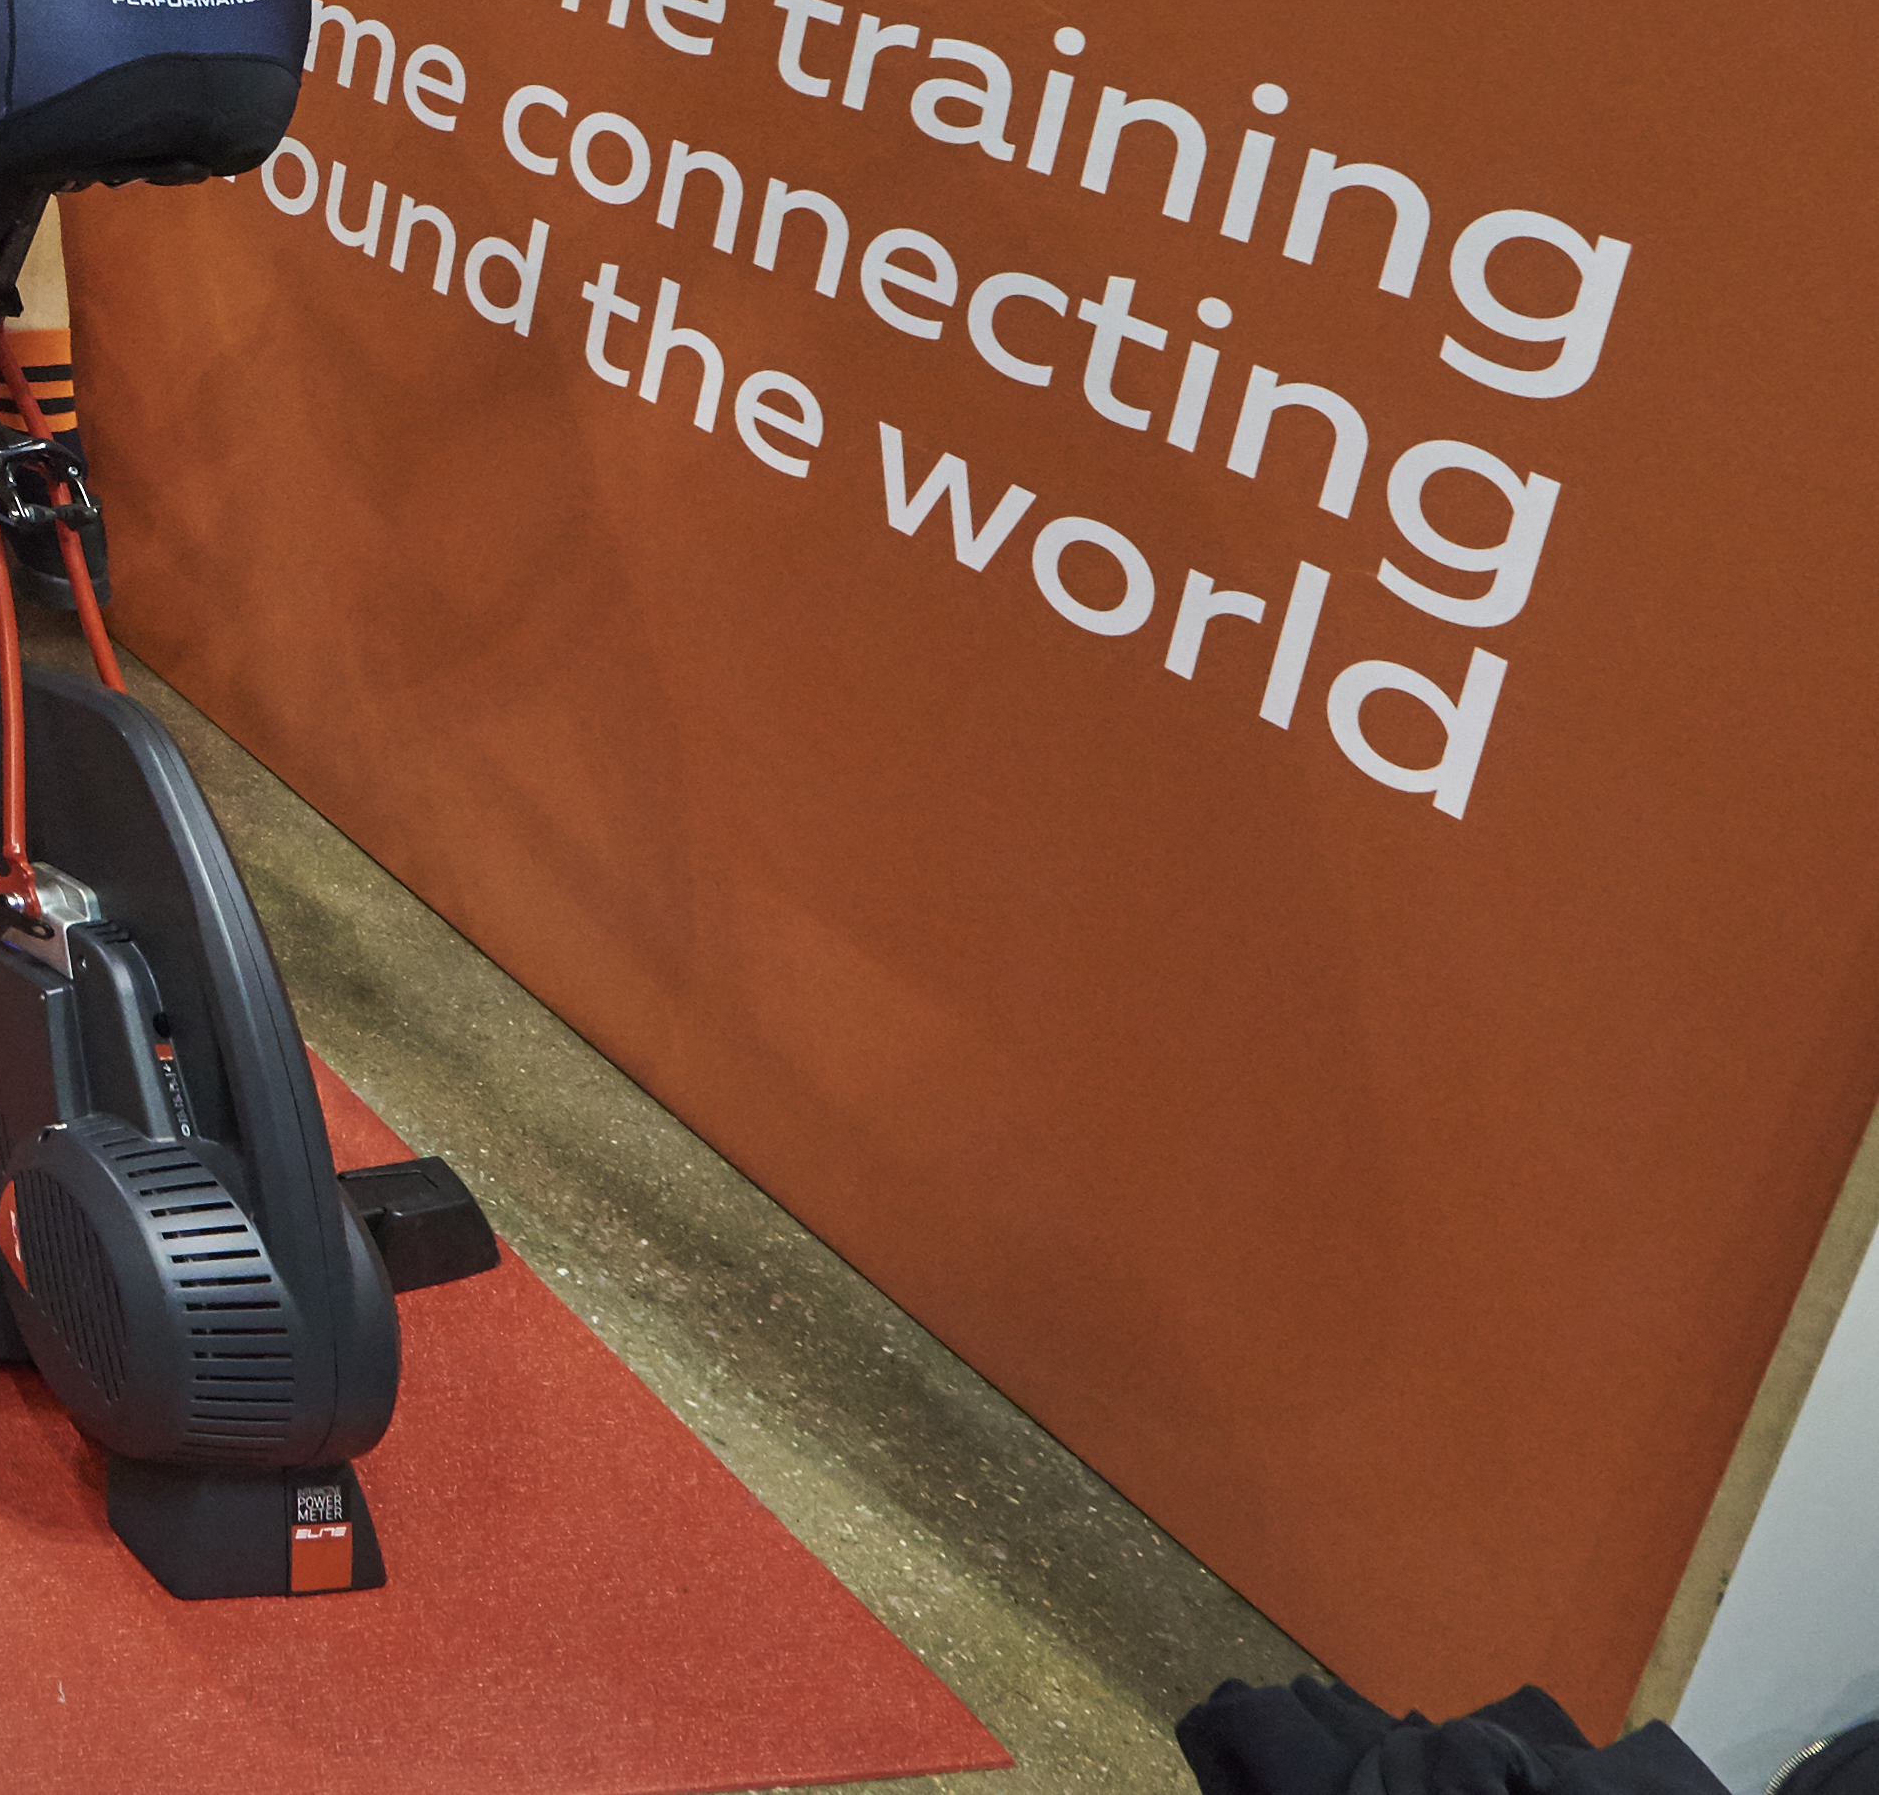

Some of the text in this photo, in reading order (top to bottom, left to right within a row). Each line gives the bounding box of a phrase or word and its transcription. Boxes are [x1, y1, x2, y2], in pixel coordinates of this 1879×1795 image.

[260, 136, 1507, 822] ound the world
[501, 84, 1561, 628] connecting
[297, 1494, 342, 1508] POWER
[297, 1508, 343, 1522] METER
